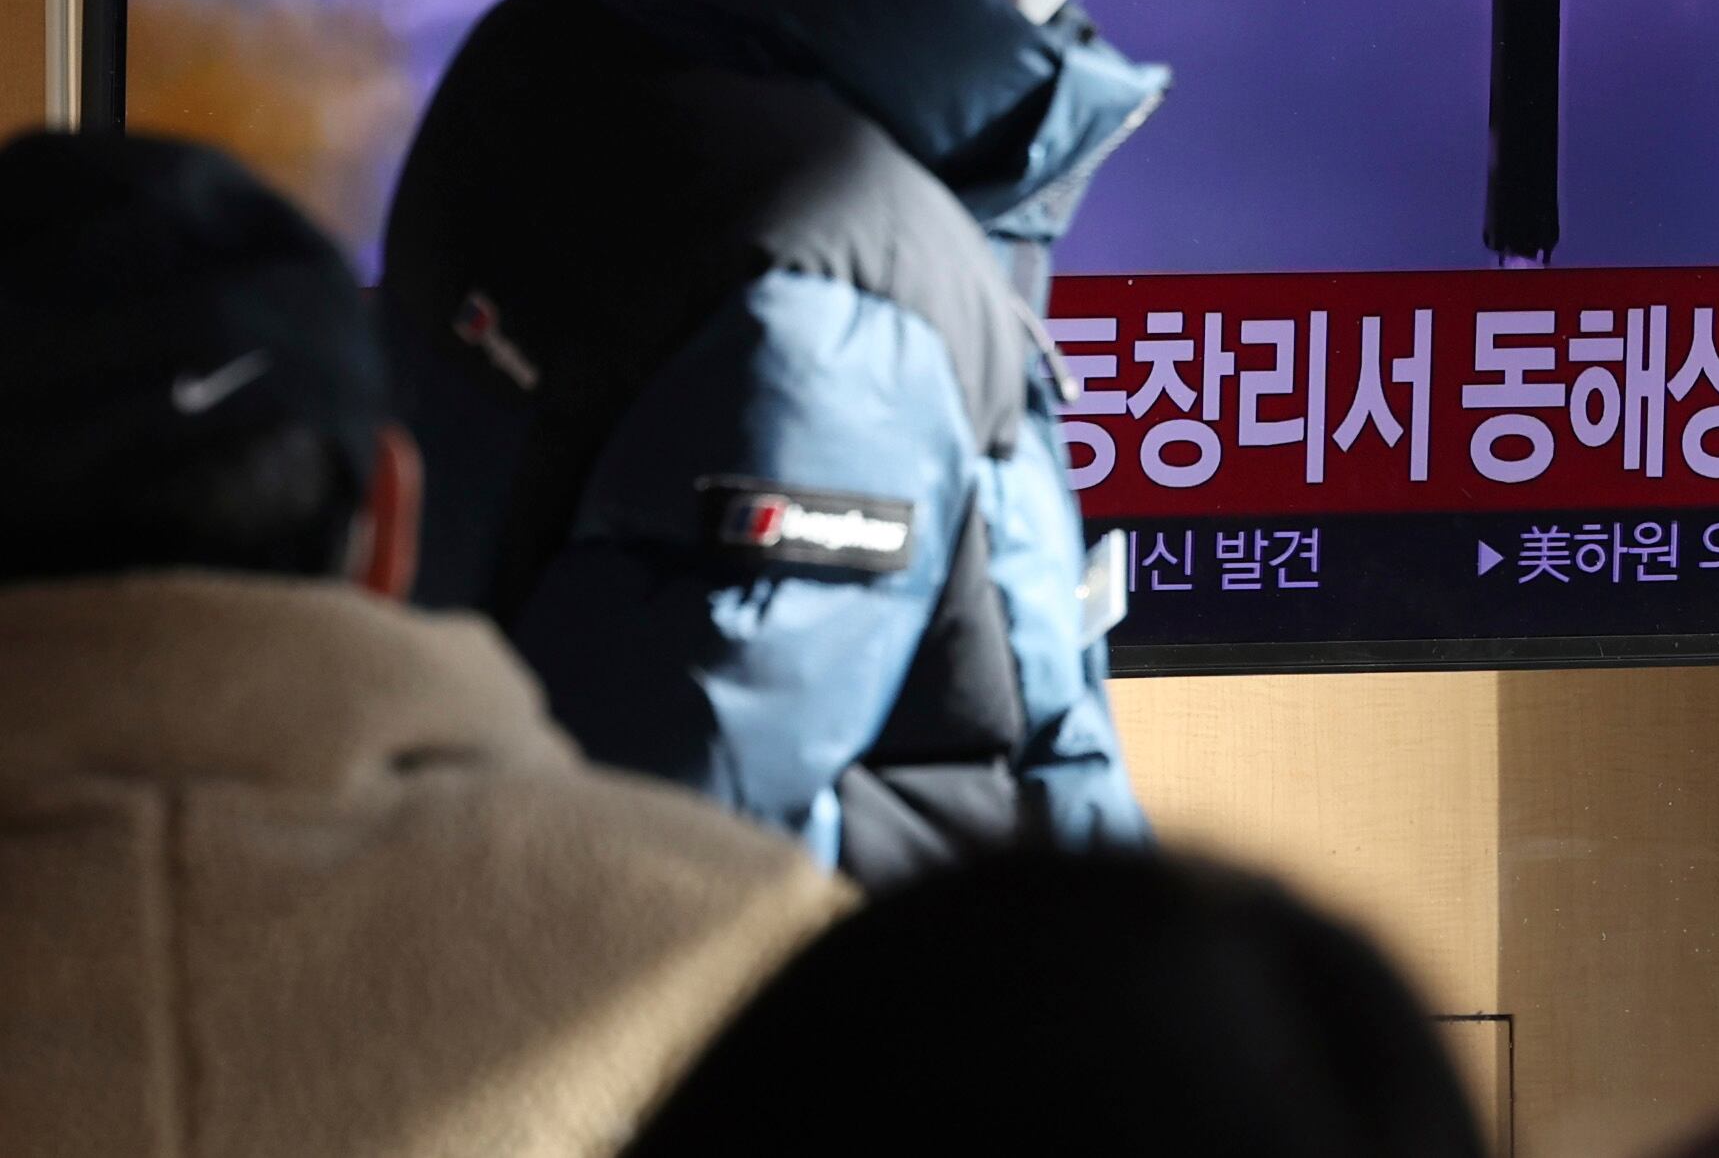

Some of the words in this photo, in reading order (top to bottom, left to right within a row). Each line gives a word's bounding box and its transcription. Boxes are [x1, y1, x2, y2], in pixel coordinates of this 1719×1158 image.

[1042, 308, 1434, 491] 동창리서
[1215, 527, 1321, 592] 발견
[1517, 520, 1680, 584] 美하원
